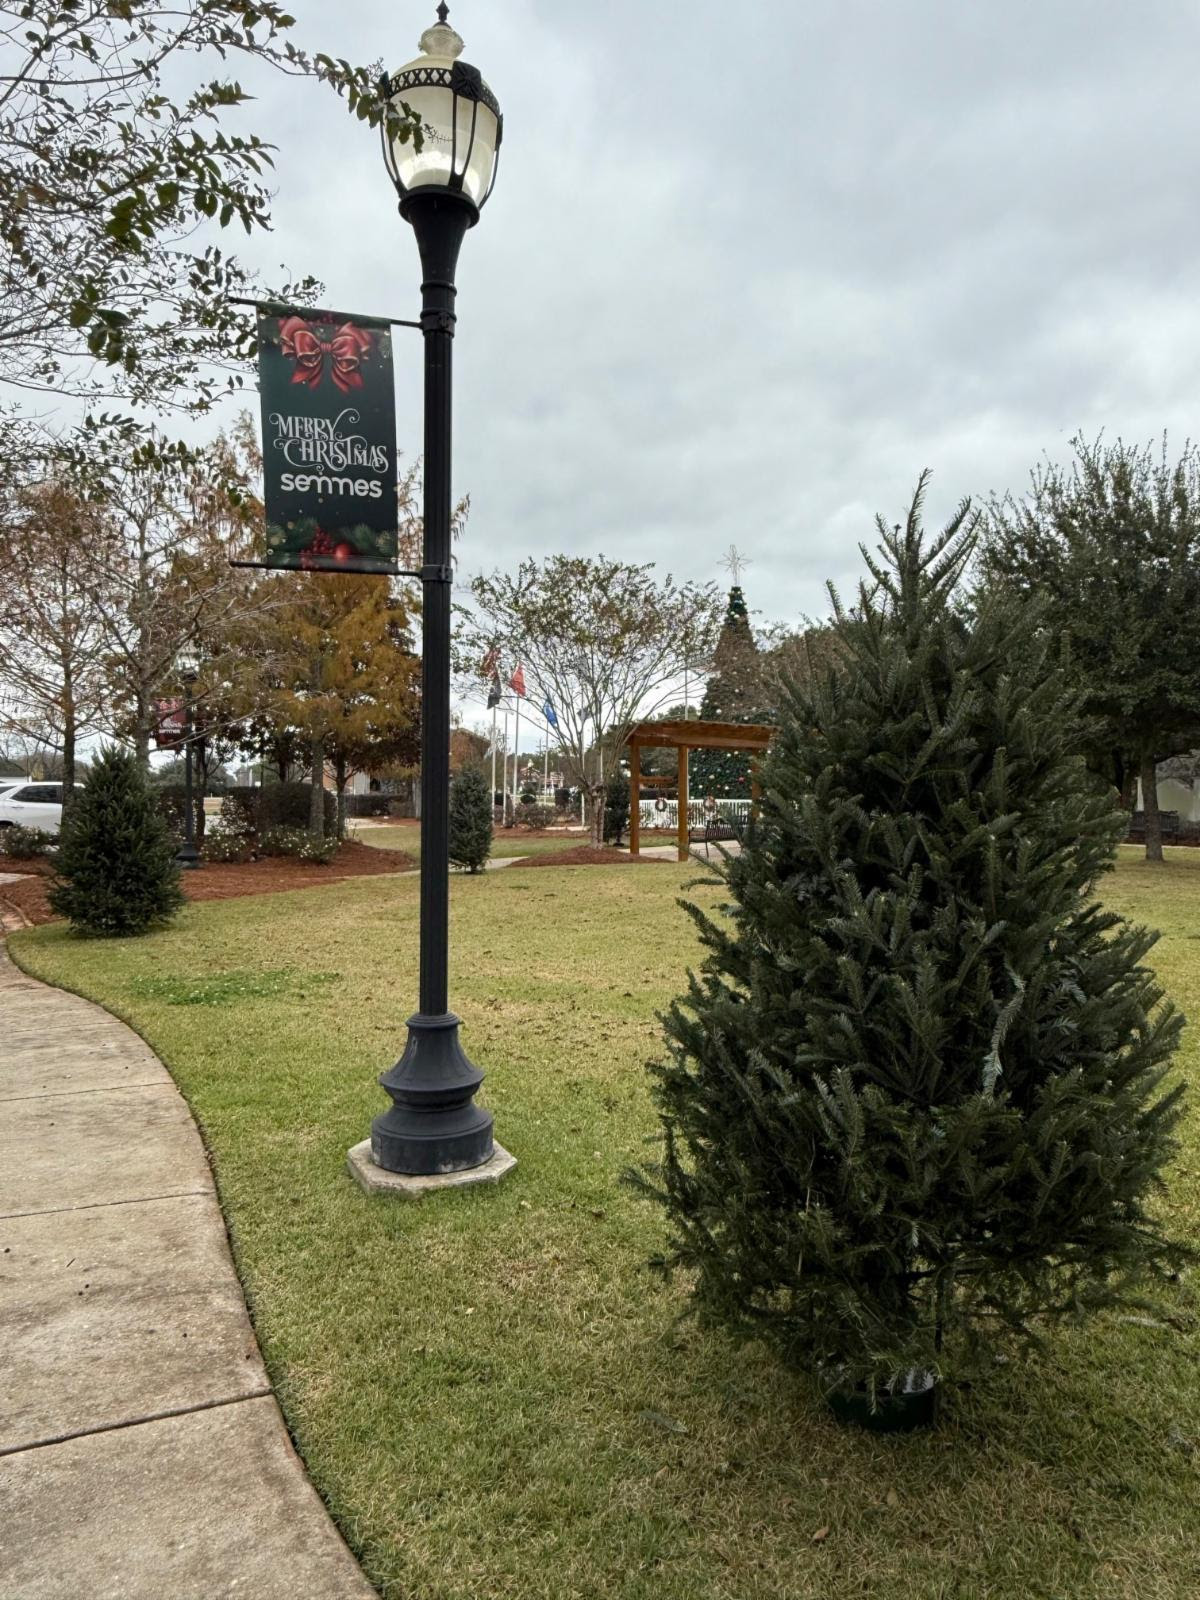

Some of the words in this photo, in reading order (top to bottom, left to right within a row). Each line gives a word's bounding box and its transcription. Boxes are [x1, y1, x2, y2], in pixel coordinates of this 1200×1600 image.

[269, 408, 360, 440] MERRY
[273, 436, 388, 473] CHRISTMAS
[280, 473, 382, 498] semmes
